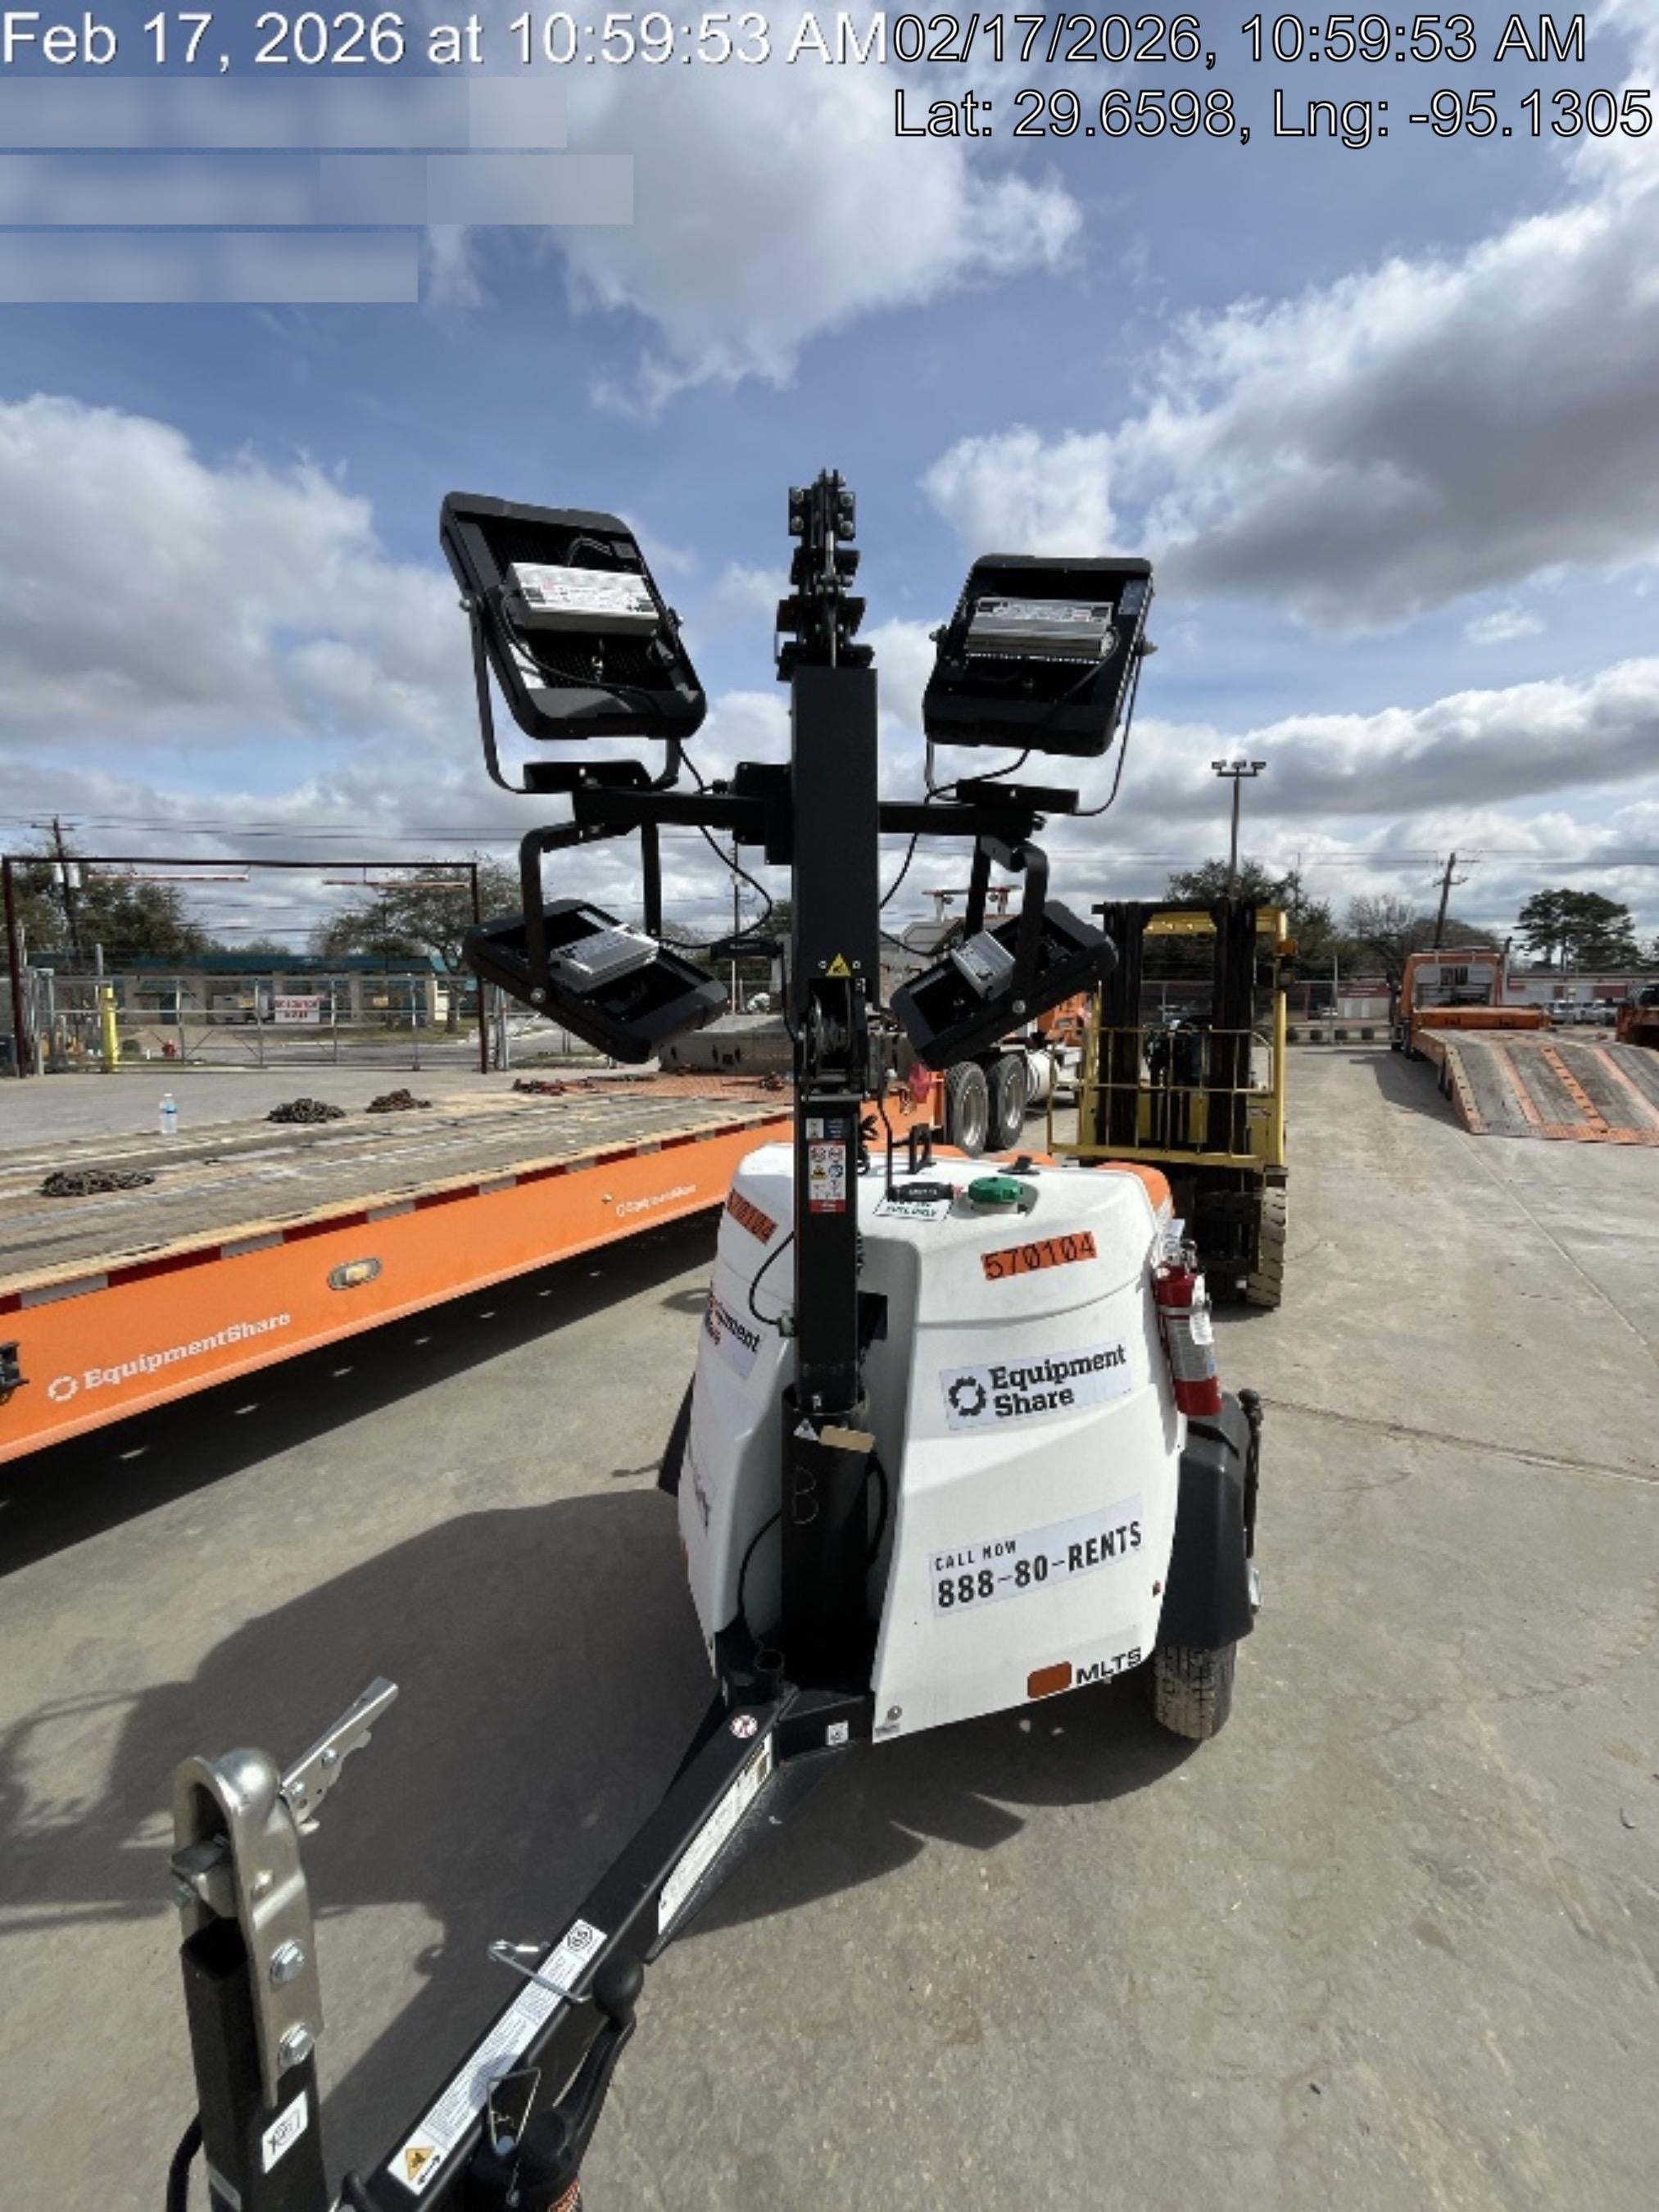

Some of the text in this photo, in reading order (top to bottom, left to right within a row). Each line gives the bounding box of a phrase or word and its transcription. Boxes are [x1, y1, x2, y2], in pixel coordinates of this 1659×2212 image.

[983, 1231, 1095, 1280] 570104
[83, 1312, 292, 1389] EquipmentShare
[988, 1344, 1127, 1391] Equipment
[995, 1388, 1074, 1417] Share
[936, 1539, 1016, 1571] CALL NOW
[938, 1520, 1142, 1607] 888-80-RENTS
[1076, 1646, 1142, 1685] MLTS
